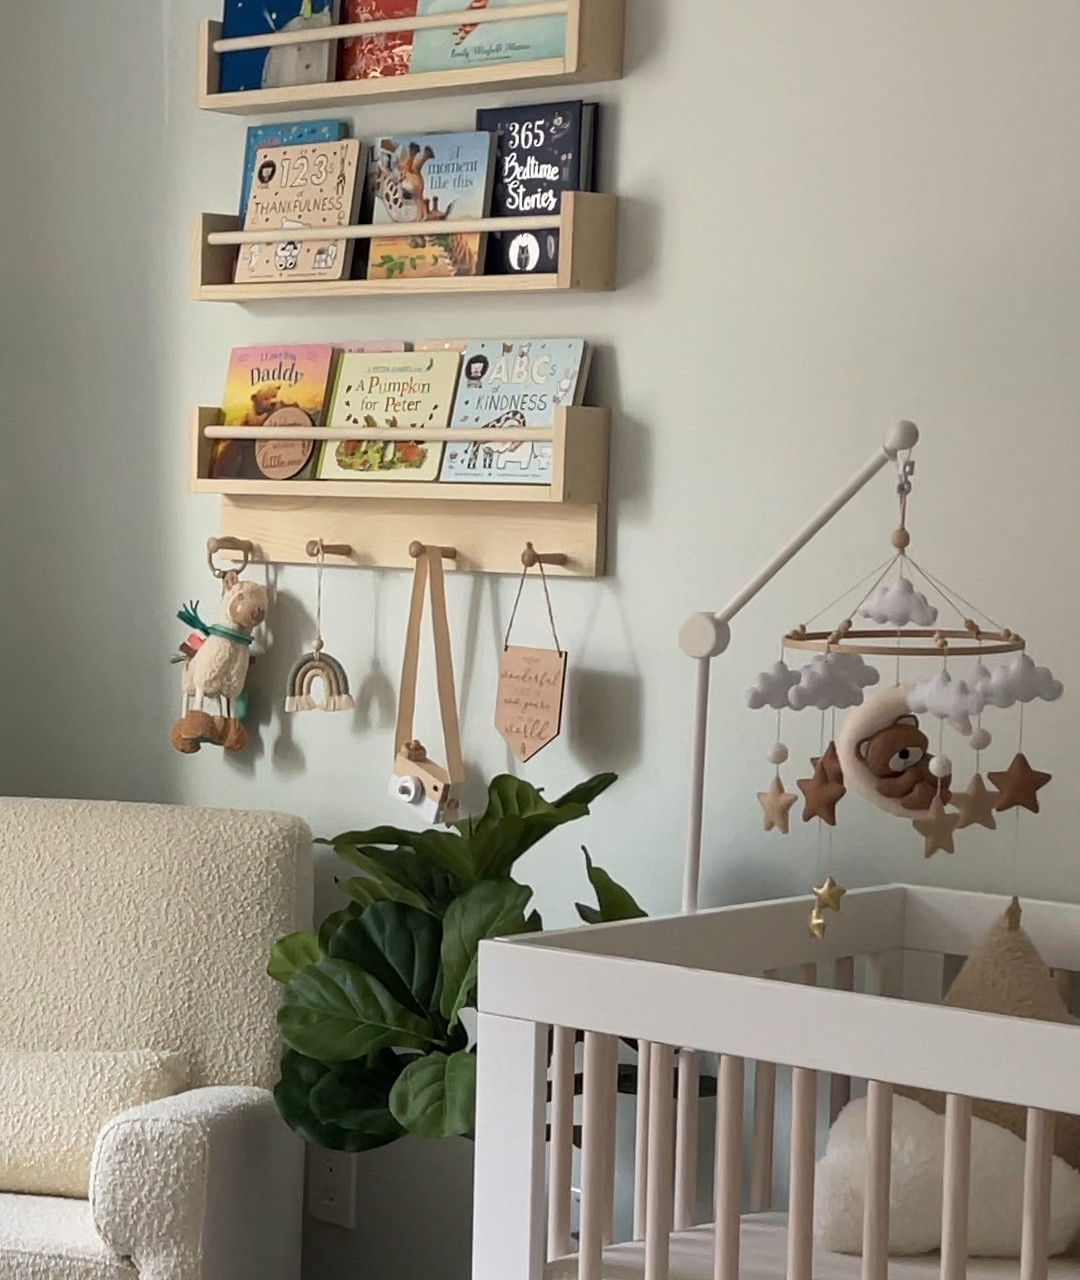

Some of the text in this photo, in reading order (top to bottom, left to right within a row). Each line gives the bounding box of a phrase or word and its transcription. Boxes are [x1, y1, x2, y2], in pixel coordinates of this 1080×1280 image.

[508, 119, 545, 149] 365
[428, 160, 478, 174] moment
[504, 152, 559, 183] Bedtime
[430, 176, 474, 190] like this
[506, 180, 557, 211] Stories
[255, 197, 343, 215] THANKFULNESS
[251, 361, 304, 387] Daddy
[355, 376, 431, 398] A Pumpkin
[361, 396, 422, 413] for Peter
[476, 394, 548, 411] KINDNESS
